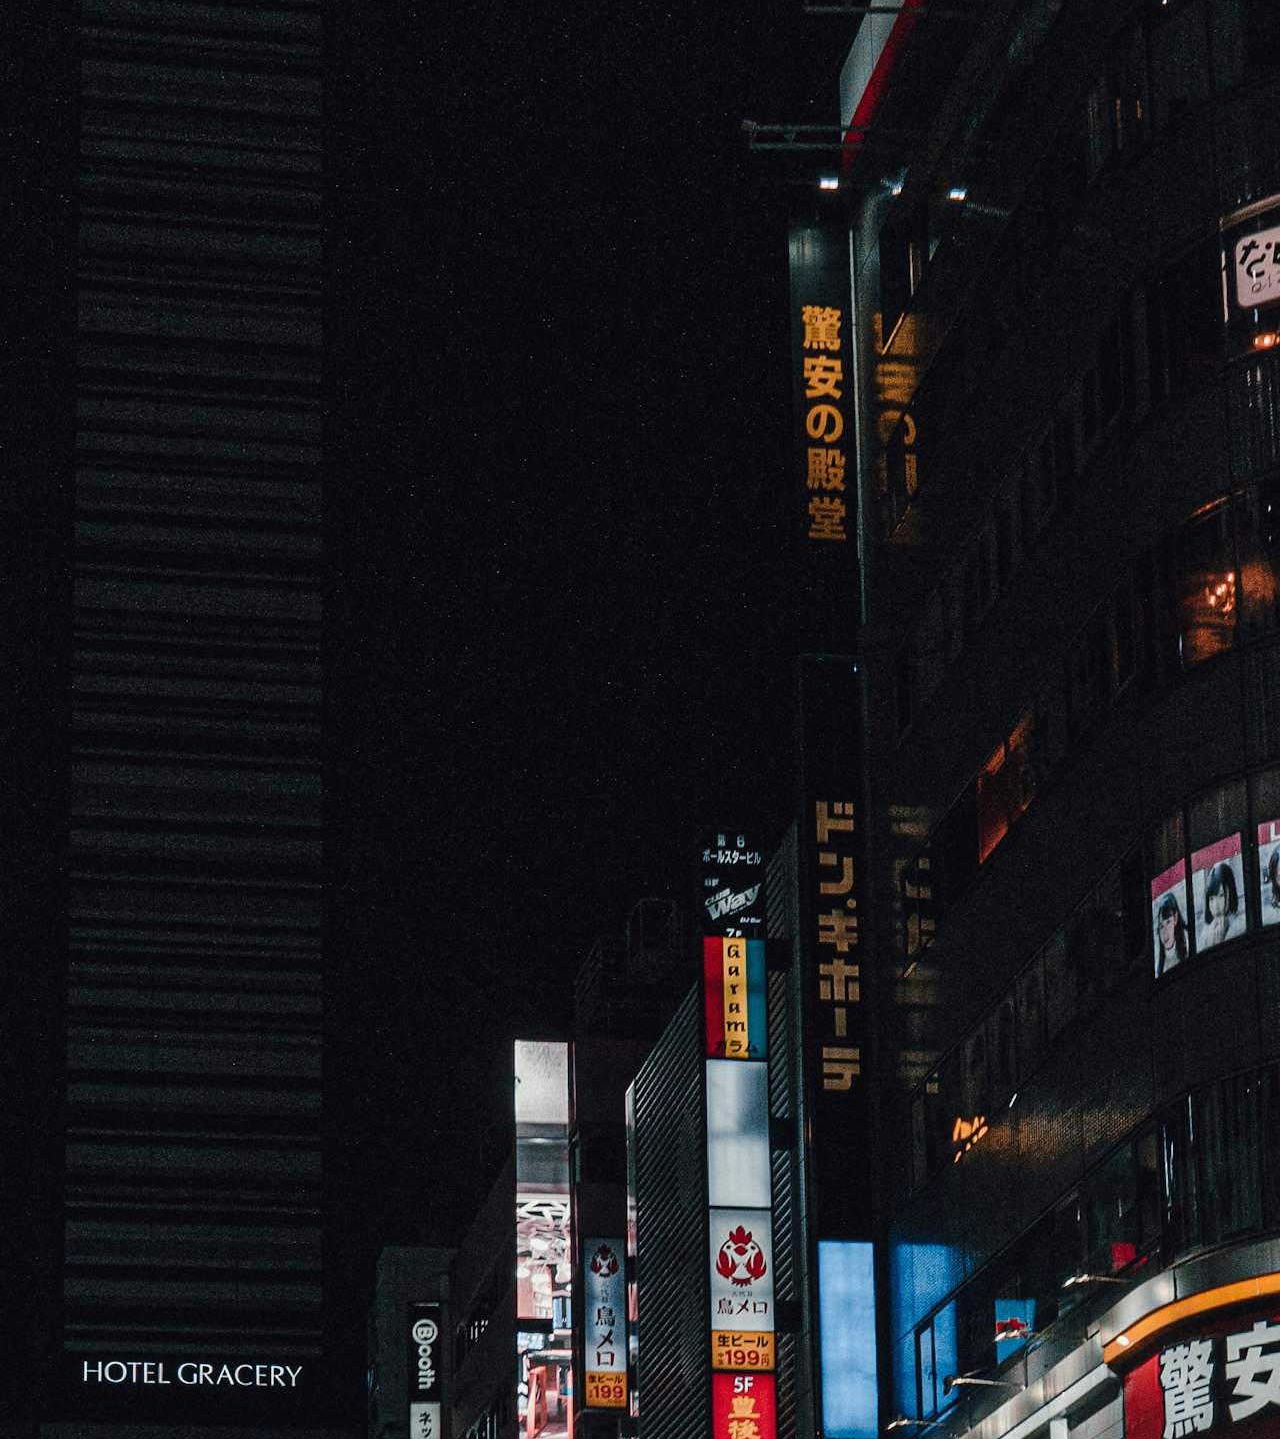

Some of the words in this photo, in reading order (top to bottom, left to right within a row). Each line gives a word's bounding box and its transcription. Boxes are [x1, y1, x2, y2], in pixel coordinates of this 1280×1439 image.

[801, 304, 848, 539] 驚安の殿堂
[717, 1298, 769, 1316] 鳥メロ
[595, 1306, 616, 1367] 鳥メロ
[717, 1334, 769, 1347] 生ビール
[411, 1318, 439, 1390] Booth
[725, 1349, 760, 1366] 199
[83, 1361, 171, 1385] HOTEL
[177, 1362, 303, 1388] GRACERY
[588, 1374, 623, 1384] 生ビール
[593, 1384, 624, 1399] 199
[733, 1376, 754, 1394] 5F
